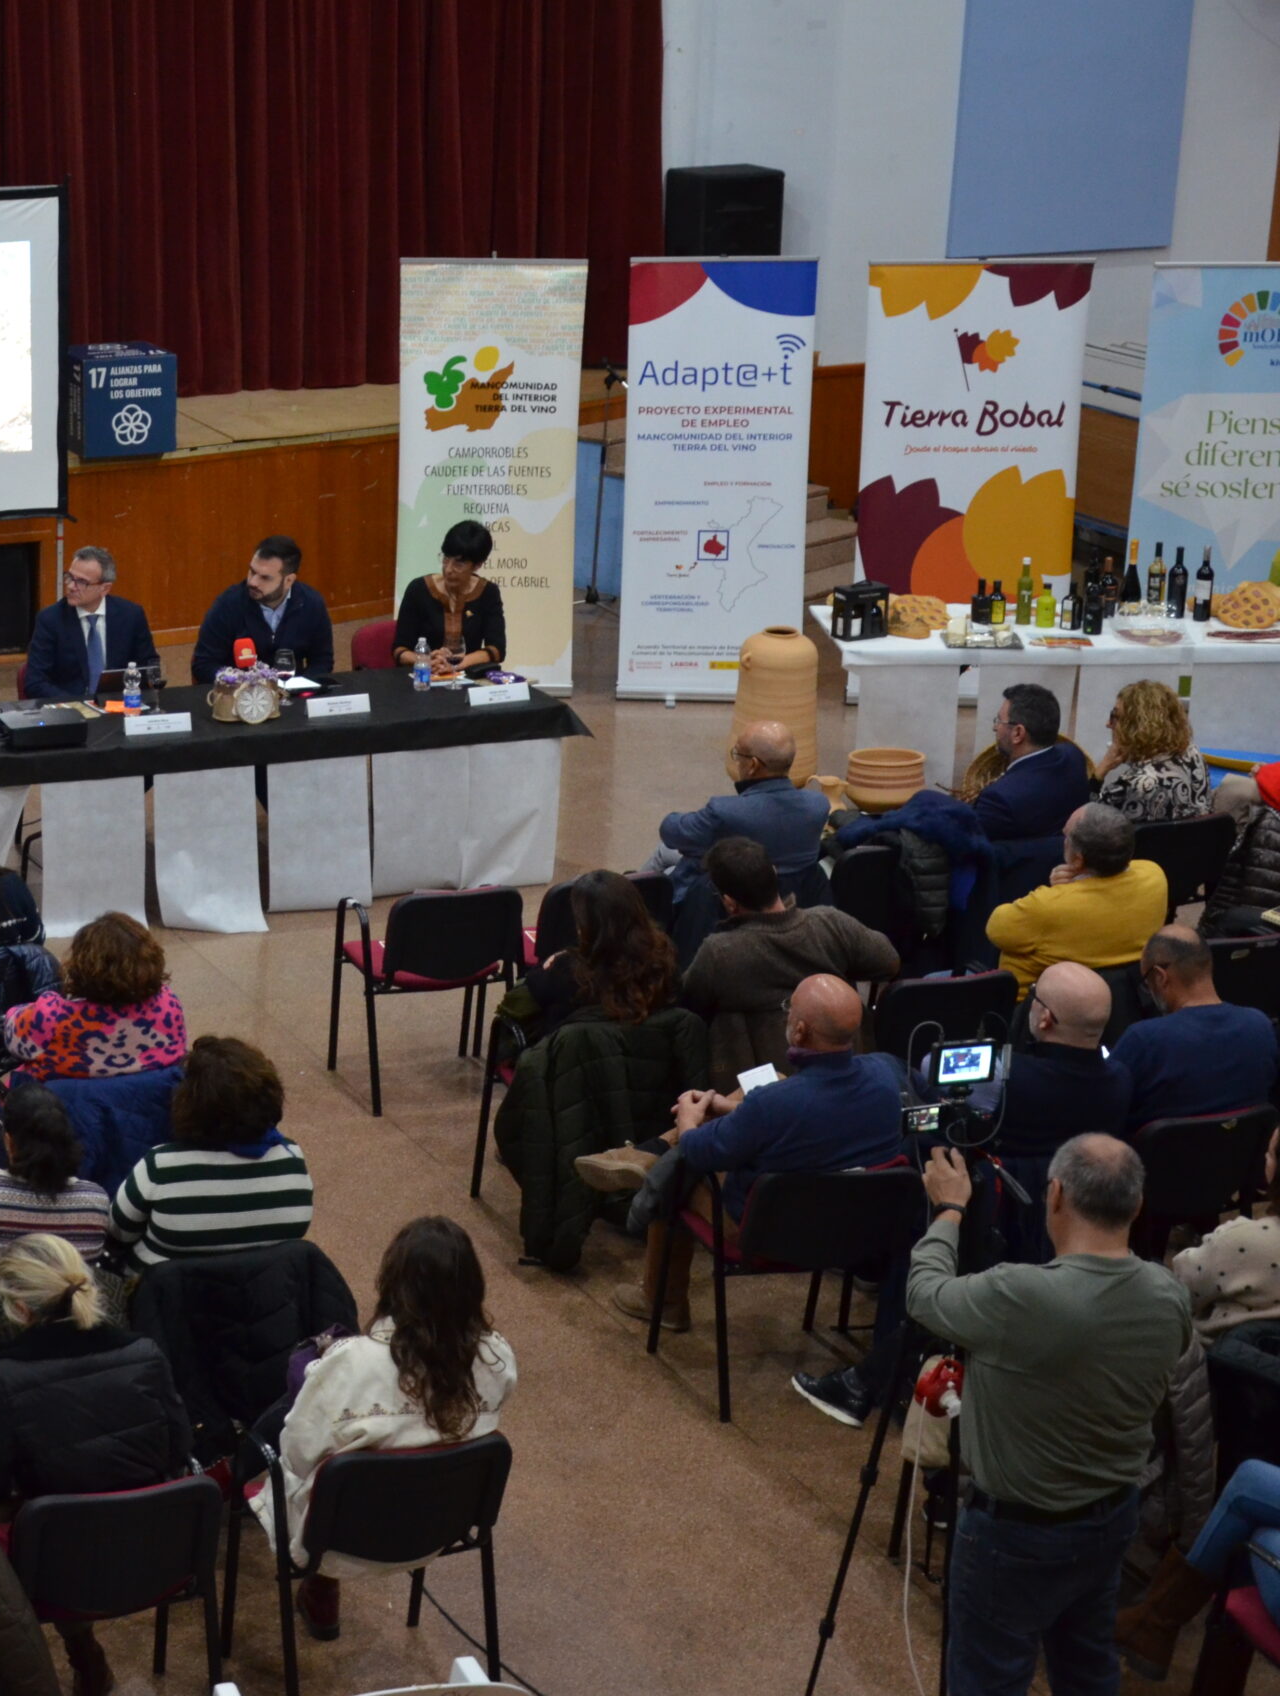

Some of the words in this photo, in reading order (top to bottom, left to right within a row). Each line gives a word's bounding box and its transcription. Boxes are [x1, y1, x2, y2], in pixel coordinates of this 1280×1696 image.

[1243, 328, 1280, 343] mO
[110, 365, 142, 376] ALIANZAS
[143, 364, 162, 374] PARA
[88, 367, 107, 389] 17
[110, 377, 138, 387] LOGRAR
[470, 382, 558, 391] MANCOMUNIDAD
[110, 390, 124, 399] LOS
[125, 387, 162, 399] OBJETIVOS
[492, 393, 510, 402] DEL
[512, 394, 557, 403] INTERIOR
[475, 404, 507, 413] TIERRA
[511, 404, 528, 413] DEL
[530, 405, 557, 414] VINO
[638, 405, 701, 416] PROYECTO
[704, 405, 794, 415] EXPERIMENTAL
[681, 418, 697, 428] DE
[700, 418, 750, 428] EMPLEO
[882, 400, 969, 429] Tierra
[975, 400, 1066, 436] Bobal
[637, 433, 723, 441] MANCOMUNIDAD
[724, 433, 744, 441] DEL
[746, 433, 793, 441] INTERIOR
[448, 447, 528, 458] CAMPORROBLES
[672, 444, 707, 452] TIERRA
[710, 444, 729, 452] DEL
[732, 444, 757, 452] VINO
[424, 465, 469, 477] CAUDETE
[471, 465, 486, 477] DE
[487, 466, 506, 477] LAS
[508, 466, 552, 478] FUENTES
[447, 484, 528, 496] FUENTERROBLES
[1160, 473, 1191, 498] sé
[463, 502, 510, 515] REQUENA
[496, 558, 528, 569] MORO
[510, 576, 550, 588] CABRIEL
